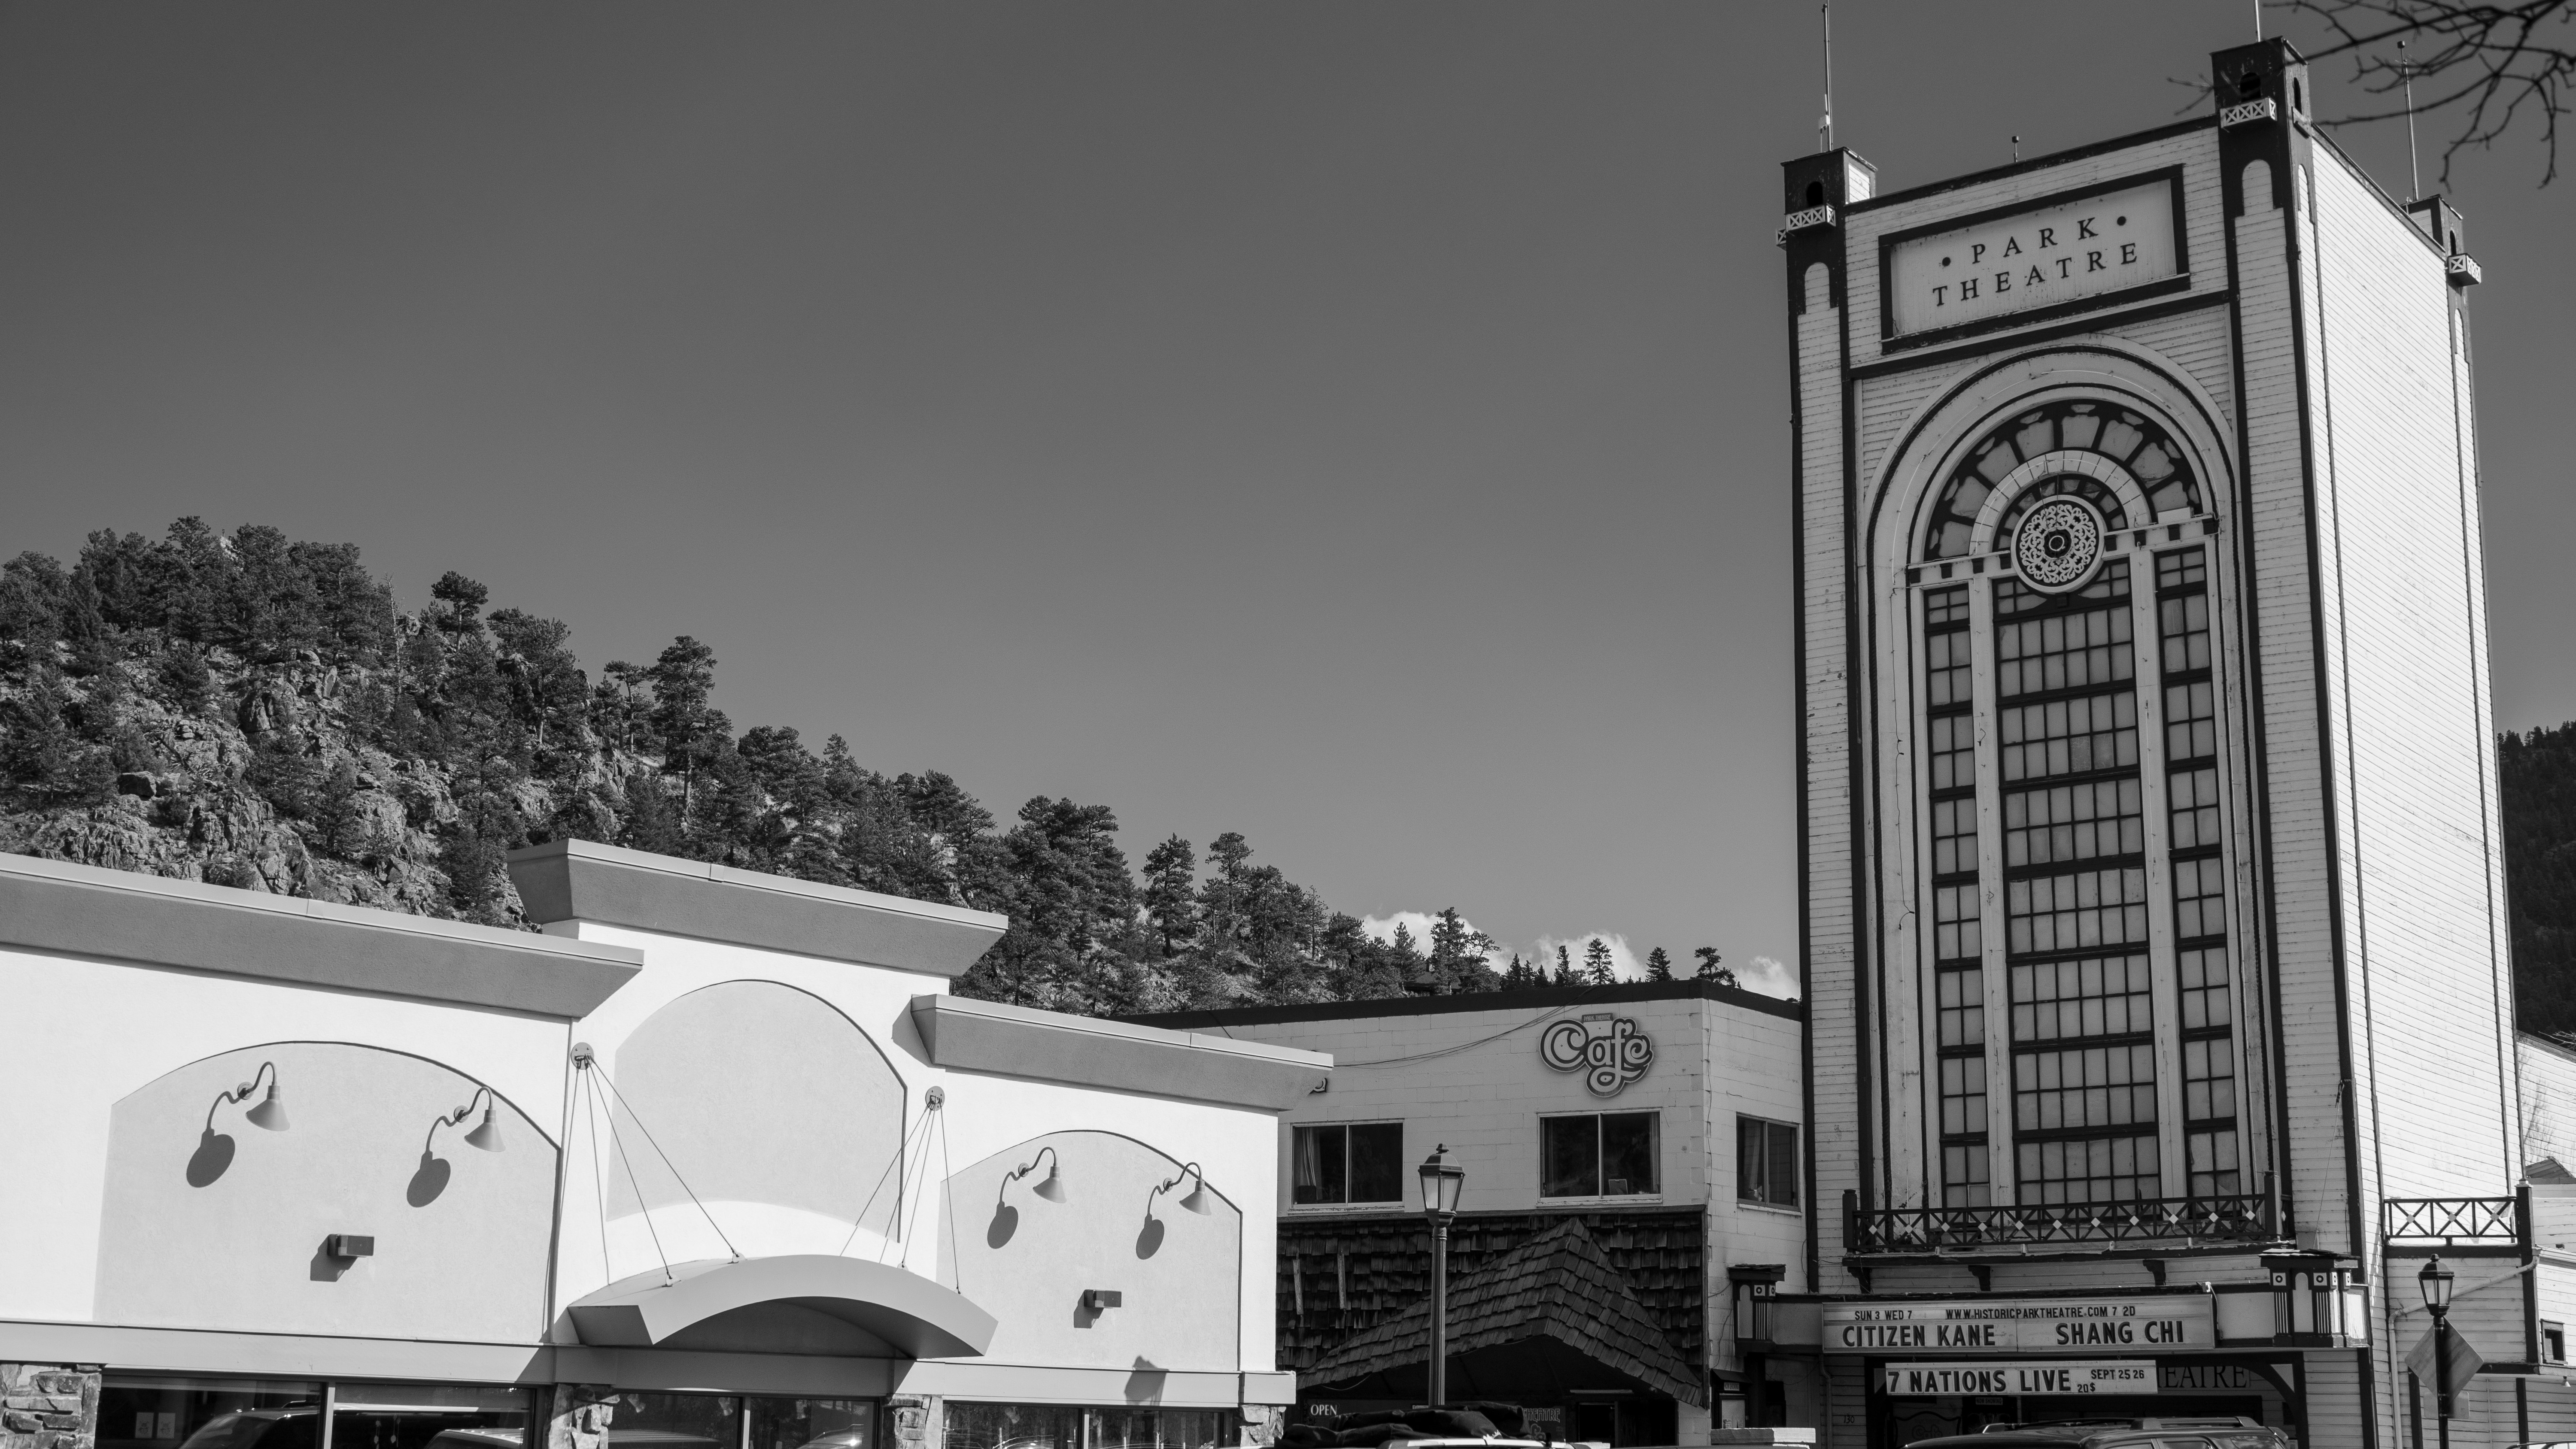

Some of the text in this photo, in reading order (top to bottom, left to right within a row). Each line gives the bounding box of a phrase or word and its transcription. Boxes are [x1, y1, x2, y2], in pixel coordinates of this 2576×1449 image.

[1971, 217, 2099, 264] PARK
[1932, 243, 2137, 306] THEATRE
[1540, 1019, 1653, 1097] Cafe
[1854, 1310, 1912, 1321] SUN 3 WED 7
[2112, 1307, 2117, 1316] 7
[2123, 1306, 2136, 1316] 2D
[1842, 1324, 1996, 1347] CITIZEN KANE
[2056, 1320, 2184, 1345] SHANG CHI
[1888, 1370, 2071, 1392] 7 NATIONS LIVE
[2091, 1369, 2144, 1379] SEPT 25 26
[2078, 1382, 2095, 1393] 20$
[1311, 1404, 1337, 1416] OPEN
[1844, 1415, 1855, 1424] 130
